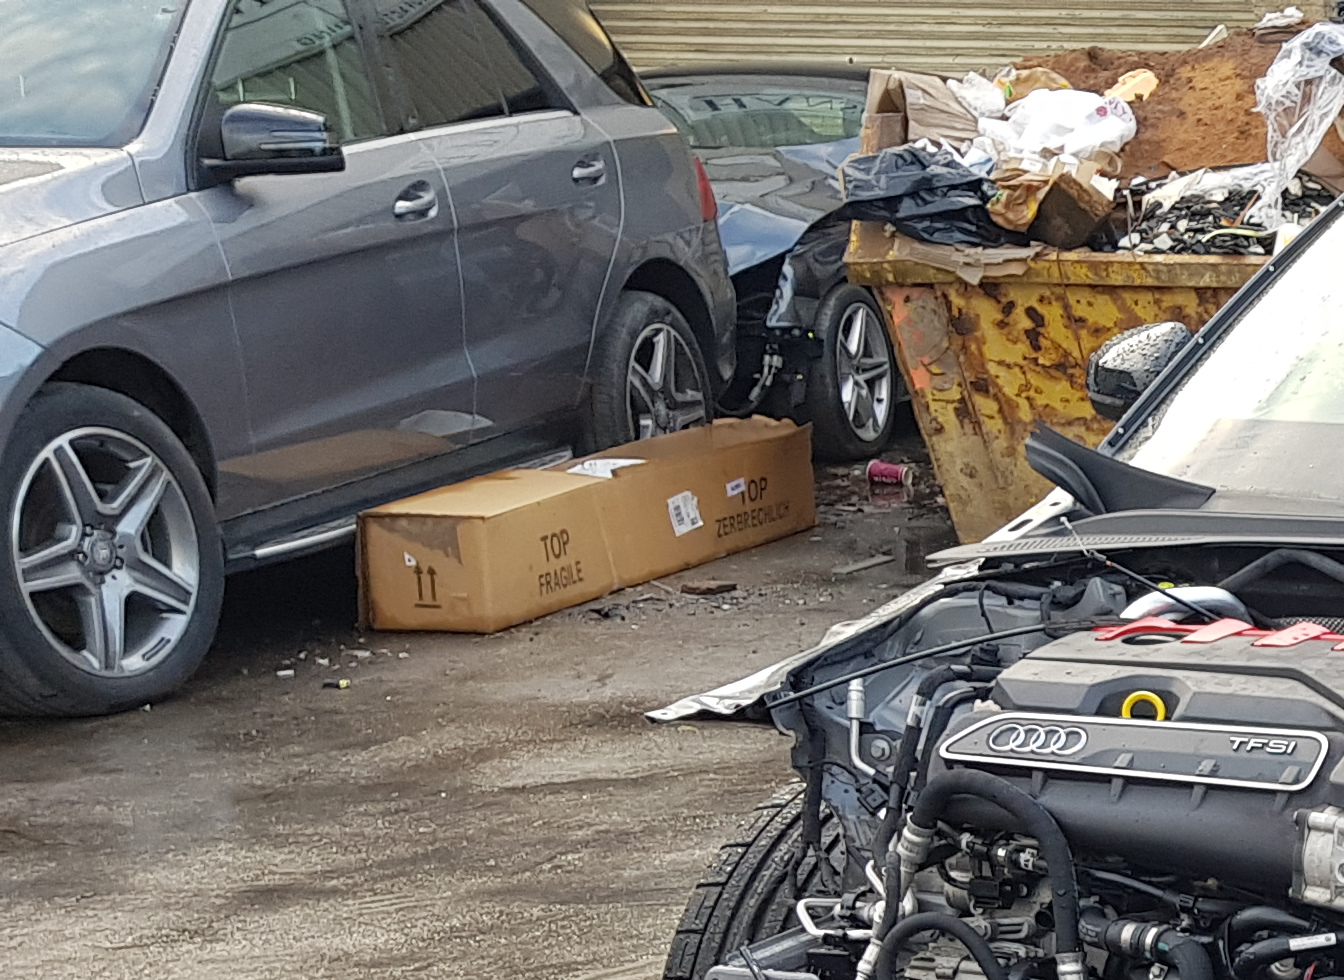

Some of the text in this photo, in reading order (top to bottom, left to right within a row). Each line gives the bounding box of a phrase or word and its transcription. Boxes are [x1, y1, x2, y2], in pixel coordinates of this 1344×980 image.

[715, 501, 790, 539] ZERBRECHLICH
[540, 528, 570, 563] TOP
[538, 560, 584, 597] FRAGILE
[1229, 736, 1297, 755] TFSI
